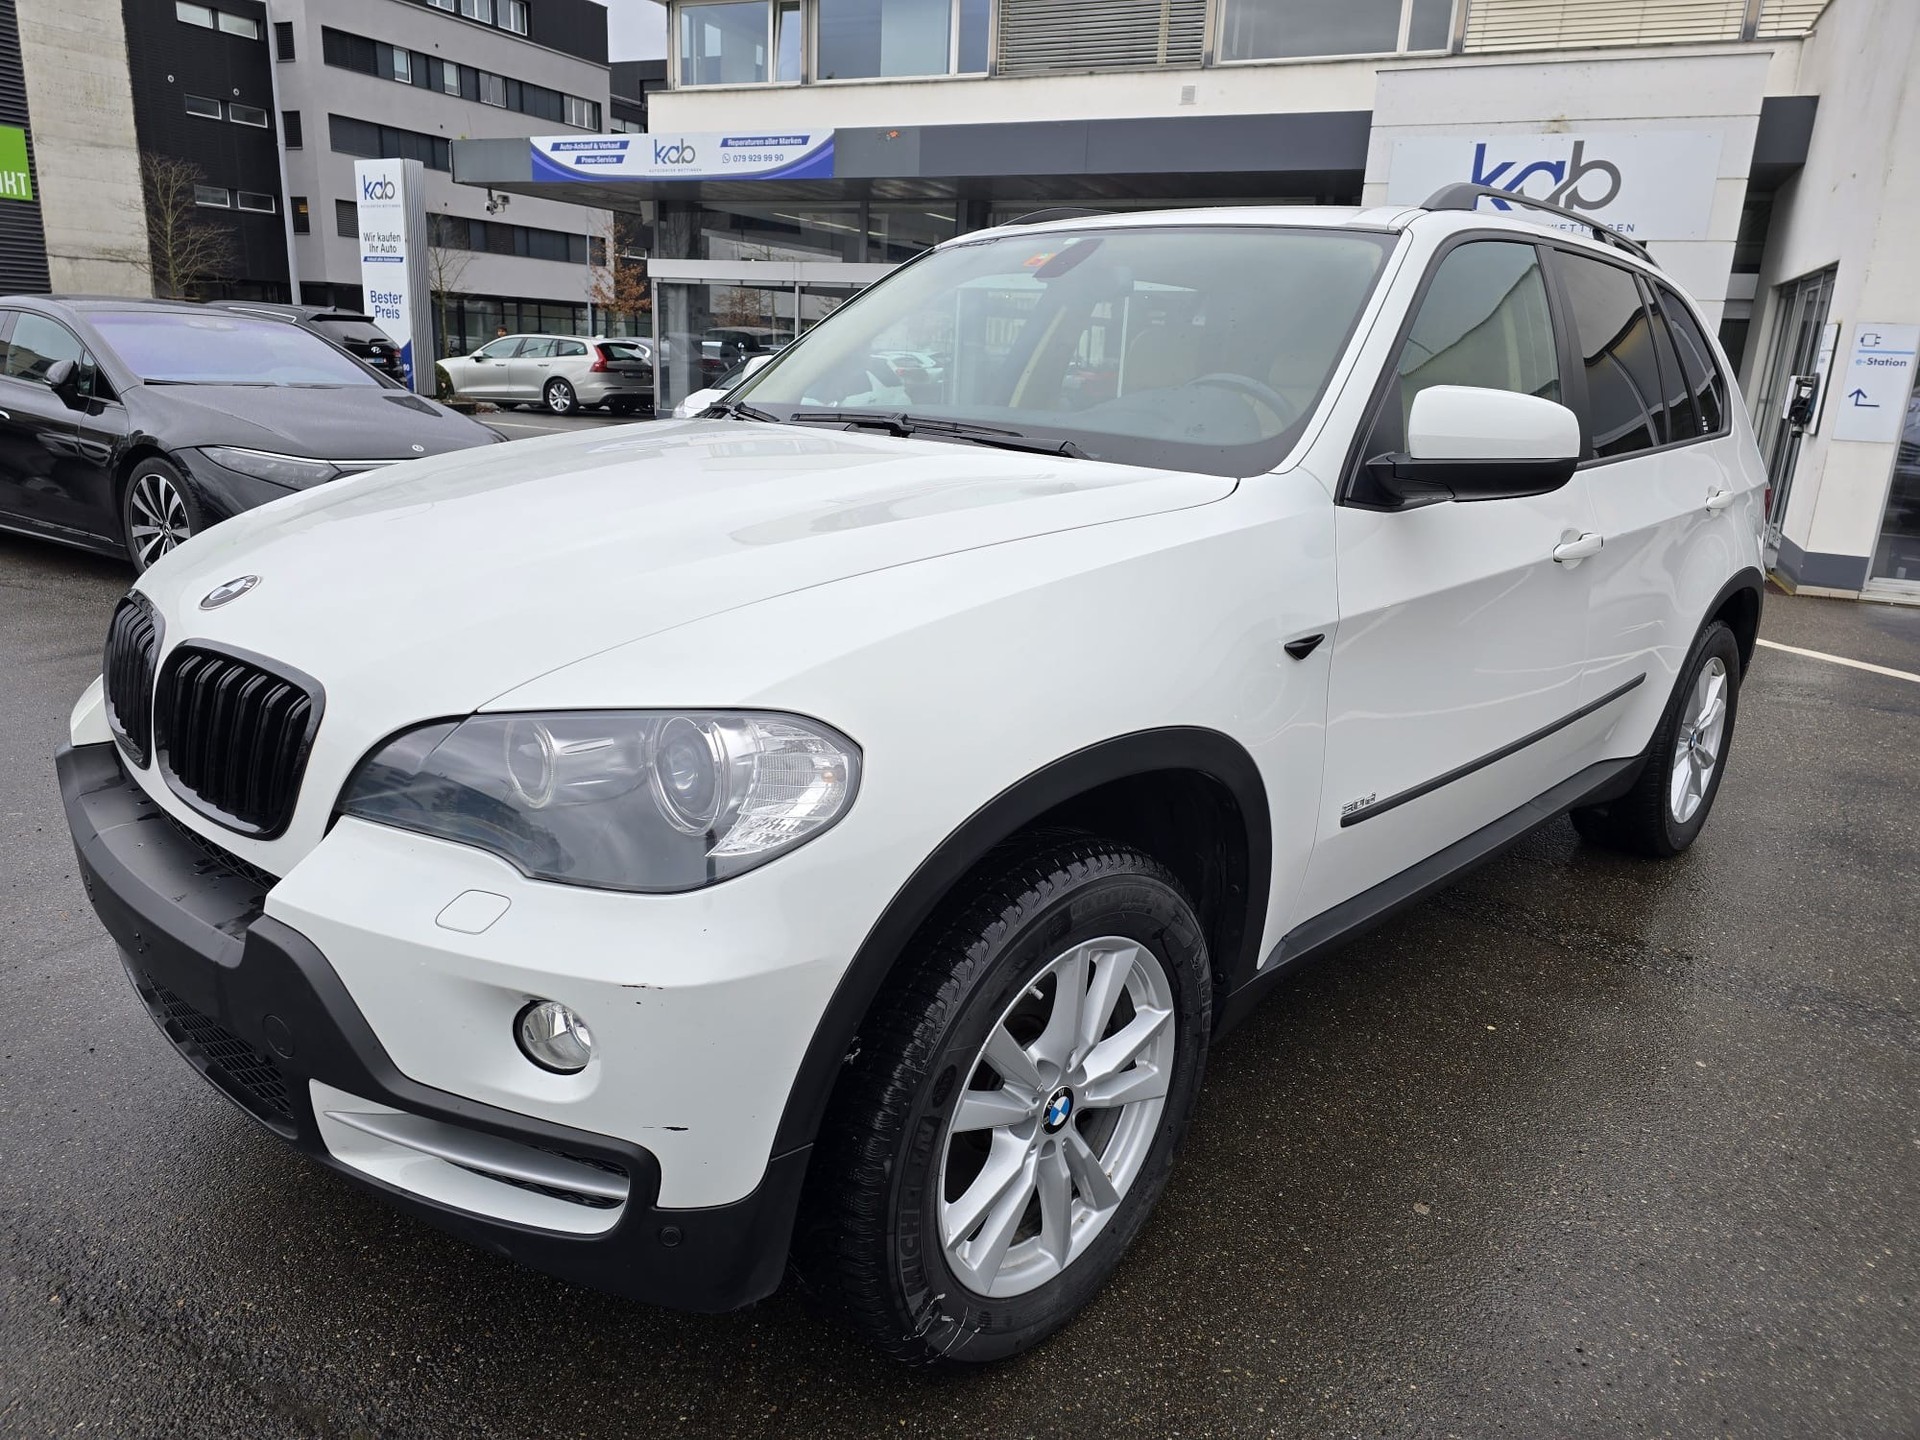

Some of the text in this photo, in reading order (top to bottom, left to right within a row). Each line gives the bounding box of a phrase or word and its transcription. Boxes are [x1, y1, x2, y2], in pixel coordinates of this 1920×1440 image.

[599, 141, 620, 149] Verkauf
[727, 138, 764, 146] Reparaturen
[779, 137, 802, 145] Marken
[654, 138, 696, 164] kab
[733, 154, 784, 162] 079 929 99 90
[1472, 140, 1621, 211] kab
[0, 171, 26, 196] KT
[363, 174, 395, 200] kab
[363, 232, 401, 242] Wir kaufen
[369, 243, 397, 253] Ihr Auto
[370, 290, 403, 305] Bester
[375, 305, 400, 320] Preis
[1856, 358, 1907, 367] e-Station
